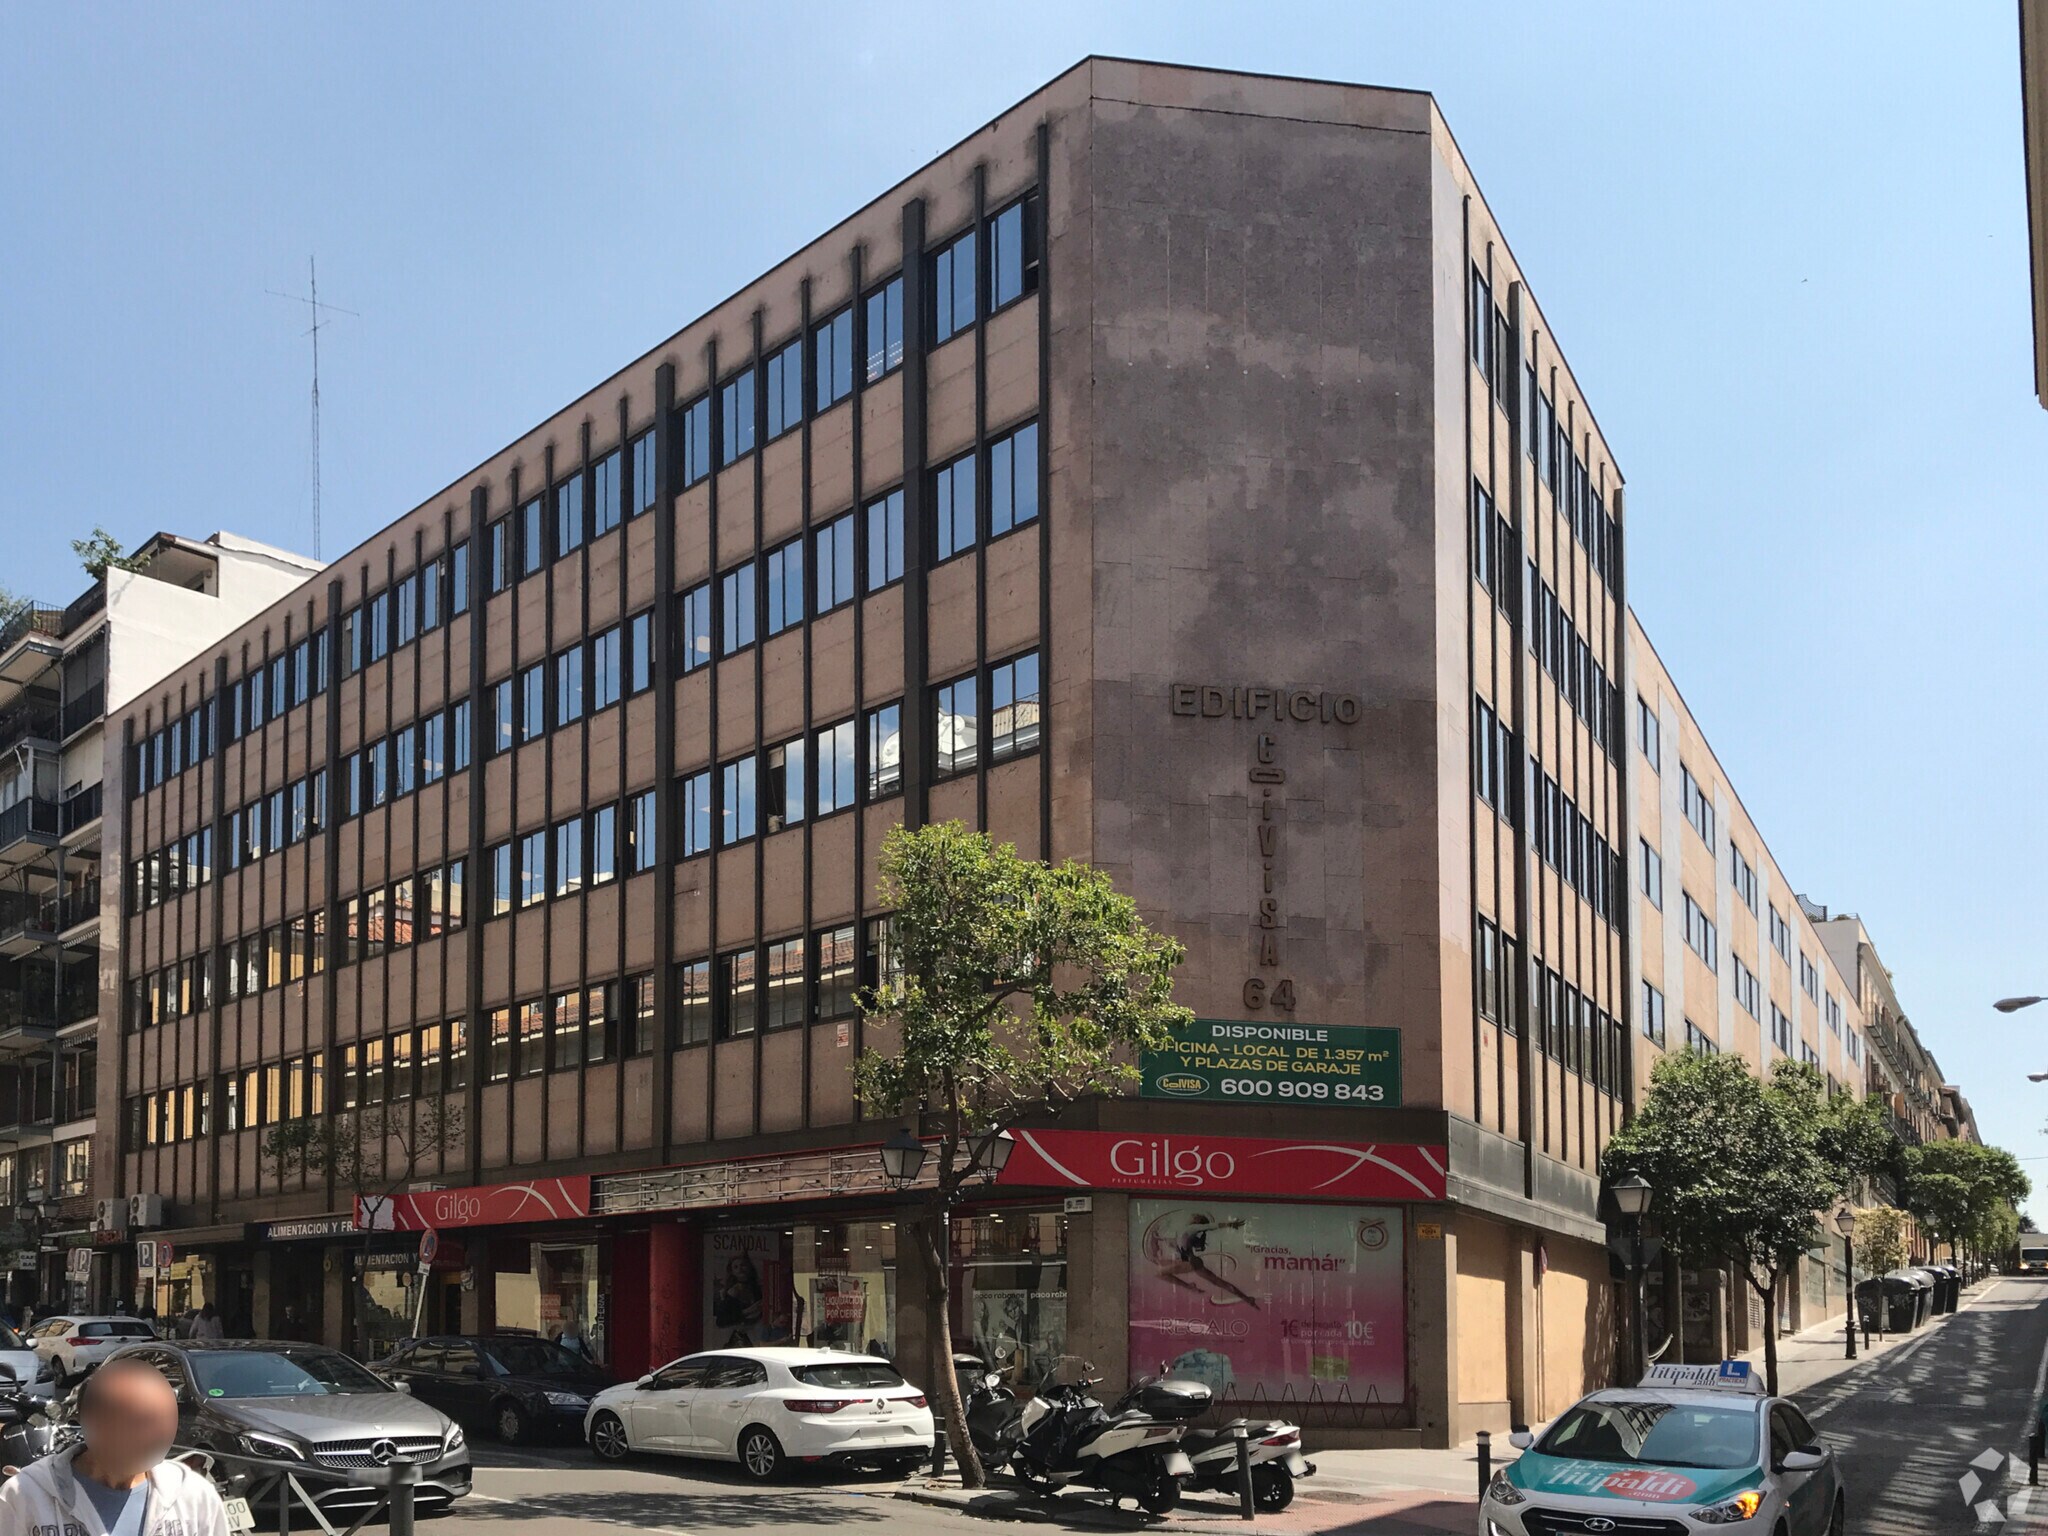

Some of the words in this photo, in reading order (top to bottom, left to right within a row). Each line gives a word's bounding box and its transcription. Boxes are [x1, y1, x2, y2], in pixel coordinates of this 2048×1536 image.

[1170, 684, 1362, 725] EDIFICIO
[1243, 979, 1296, 1012] 64
[1212, 1025, 1328, 1042] DISPONIBLE
[1234, 1044, 1290, 1057] LOCAL
[1296, 1047, 1318, 1059] DE
[1324, 1048, 1364, 1061] 1.357
[1180, 1056, 1191, 1067] Y
[1195, 1057, 1262, 1071] PLAZAS
[1266, 1060, 1288, 1072] DE
[1291, 1061, 1361, 1075] GARAJE
[1221, 1079, 1273, 1096] 600
[1278, 1081, 1329, 1099] 909
[1334, 1084, 1384, 1101] 843
[1110, 1139, 1235, 1186] Gilgo
[435, 1193, 480, 1224] Gilgo
[267, 1222, 328, 1238] ALIMENTACION
[332, 1222, 338, 1233] Y
[341, 1220, 359, 1232] FR
[714, 1234, 770, 1252] SCANDAL
[354, 1254, 409, 1266] ALMENTACION
[1161, 1318, 1250, 1336] REGALO
[1281, 1319, 1298, 1337] 1€
[1727, 1363, 1740, 1375] L
